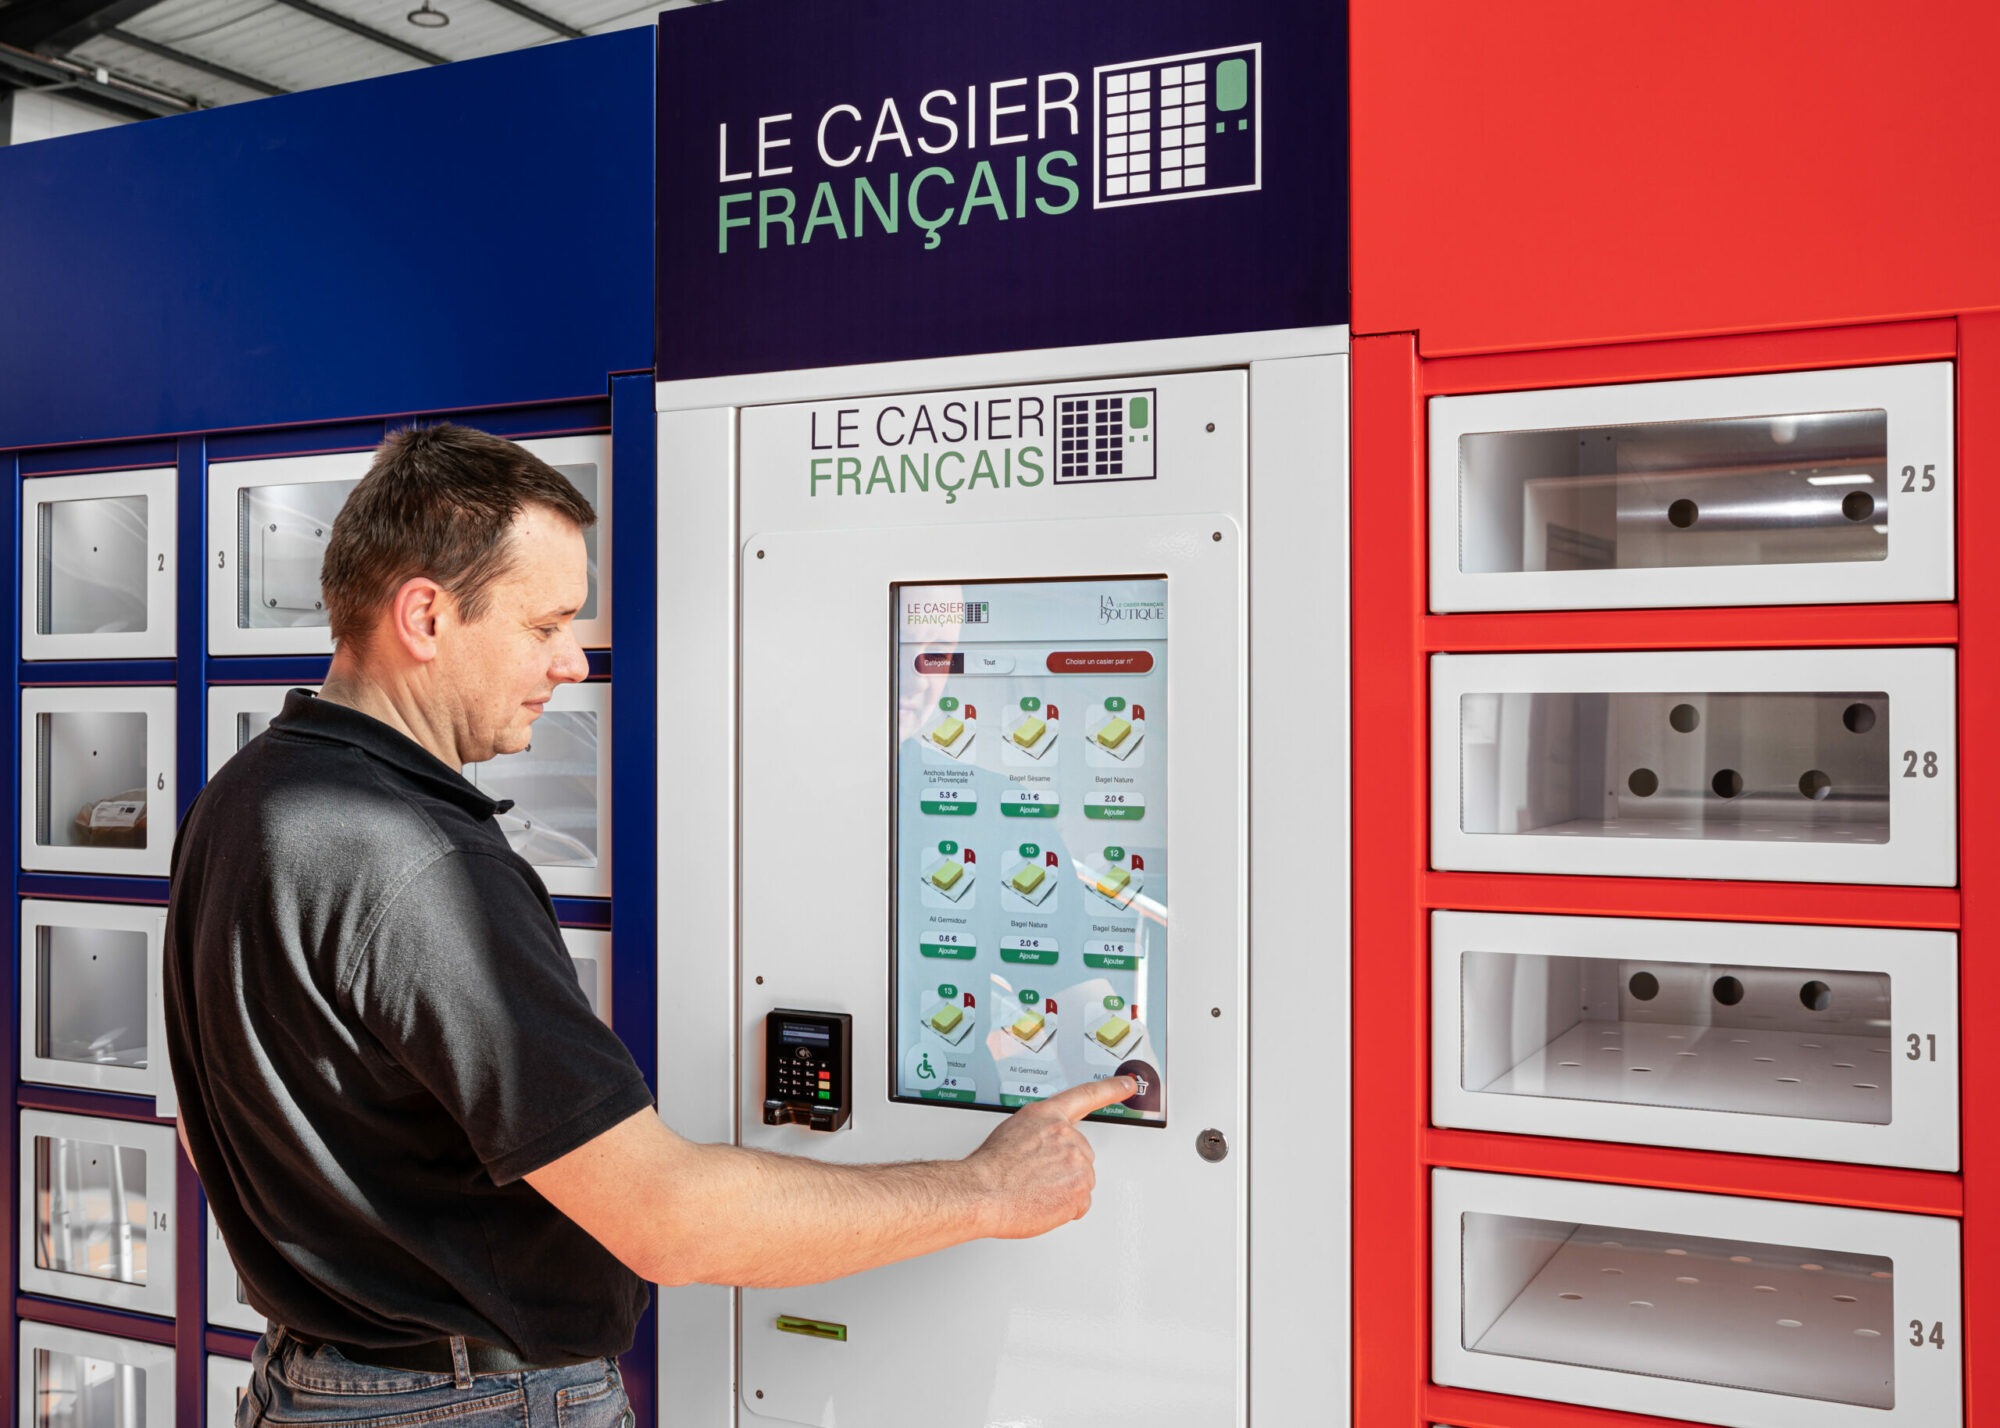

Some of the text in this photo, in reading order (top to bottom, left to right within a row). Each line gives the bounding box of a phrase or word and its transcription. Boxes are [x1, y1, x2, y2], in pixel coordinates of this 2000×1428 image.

[719, 71, 1079, 183] LE CASIER
[718, 150, 1080, 254] FRANÇAIS
[810, 396, 1045, 451] LE CASIER
[809, 445, 1045, 504] FRANÇAIS
[1901, 465, 1936, 493] 25
[158, 553, 164, 571] 2
[218, 550, 225, 568] 3
[907, 603, 964, 614] LE CASIER
[1100, 594, 1114, 607] LA
[907, 614, 964, 627] FRANÇAIS
[1100, 606, 1164, 624] BOUTIQUE
[1903, 750, 1938, 778] 28
[157, 772, 164, 790] 6
[1009, 774, 1026, 782] Bagel
[1095, 776, 1112, 784] Bagel
[1020, 806, 1040, 814] Ajouter
[1010, 920, 1027, 928] Bagel
[1020, 939, 1031, 947] 2.0
[1019, 952, 1040, 960] Ajouter
[1906, 1033, 1937, 1062] 31
[1020, 1085, 1031, 1093] 0.6
[154, 1211, 167, 1231] 14
[1909, 1319, 1944, 1350] 34
